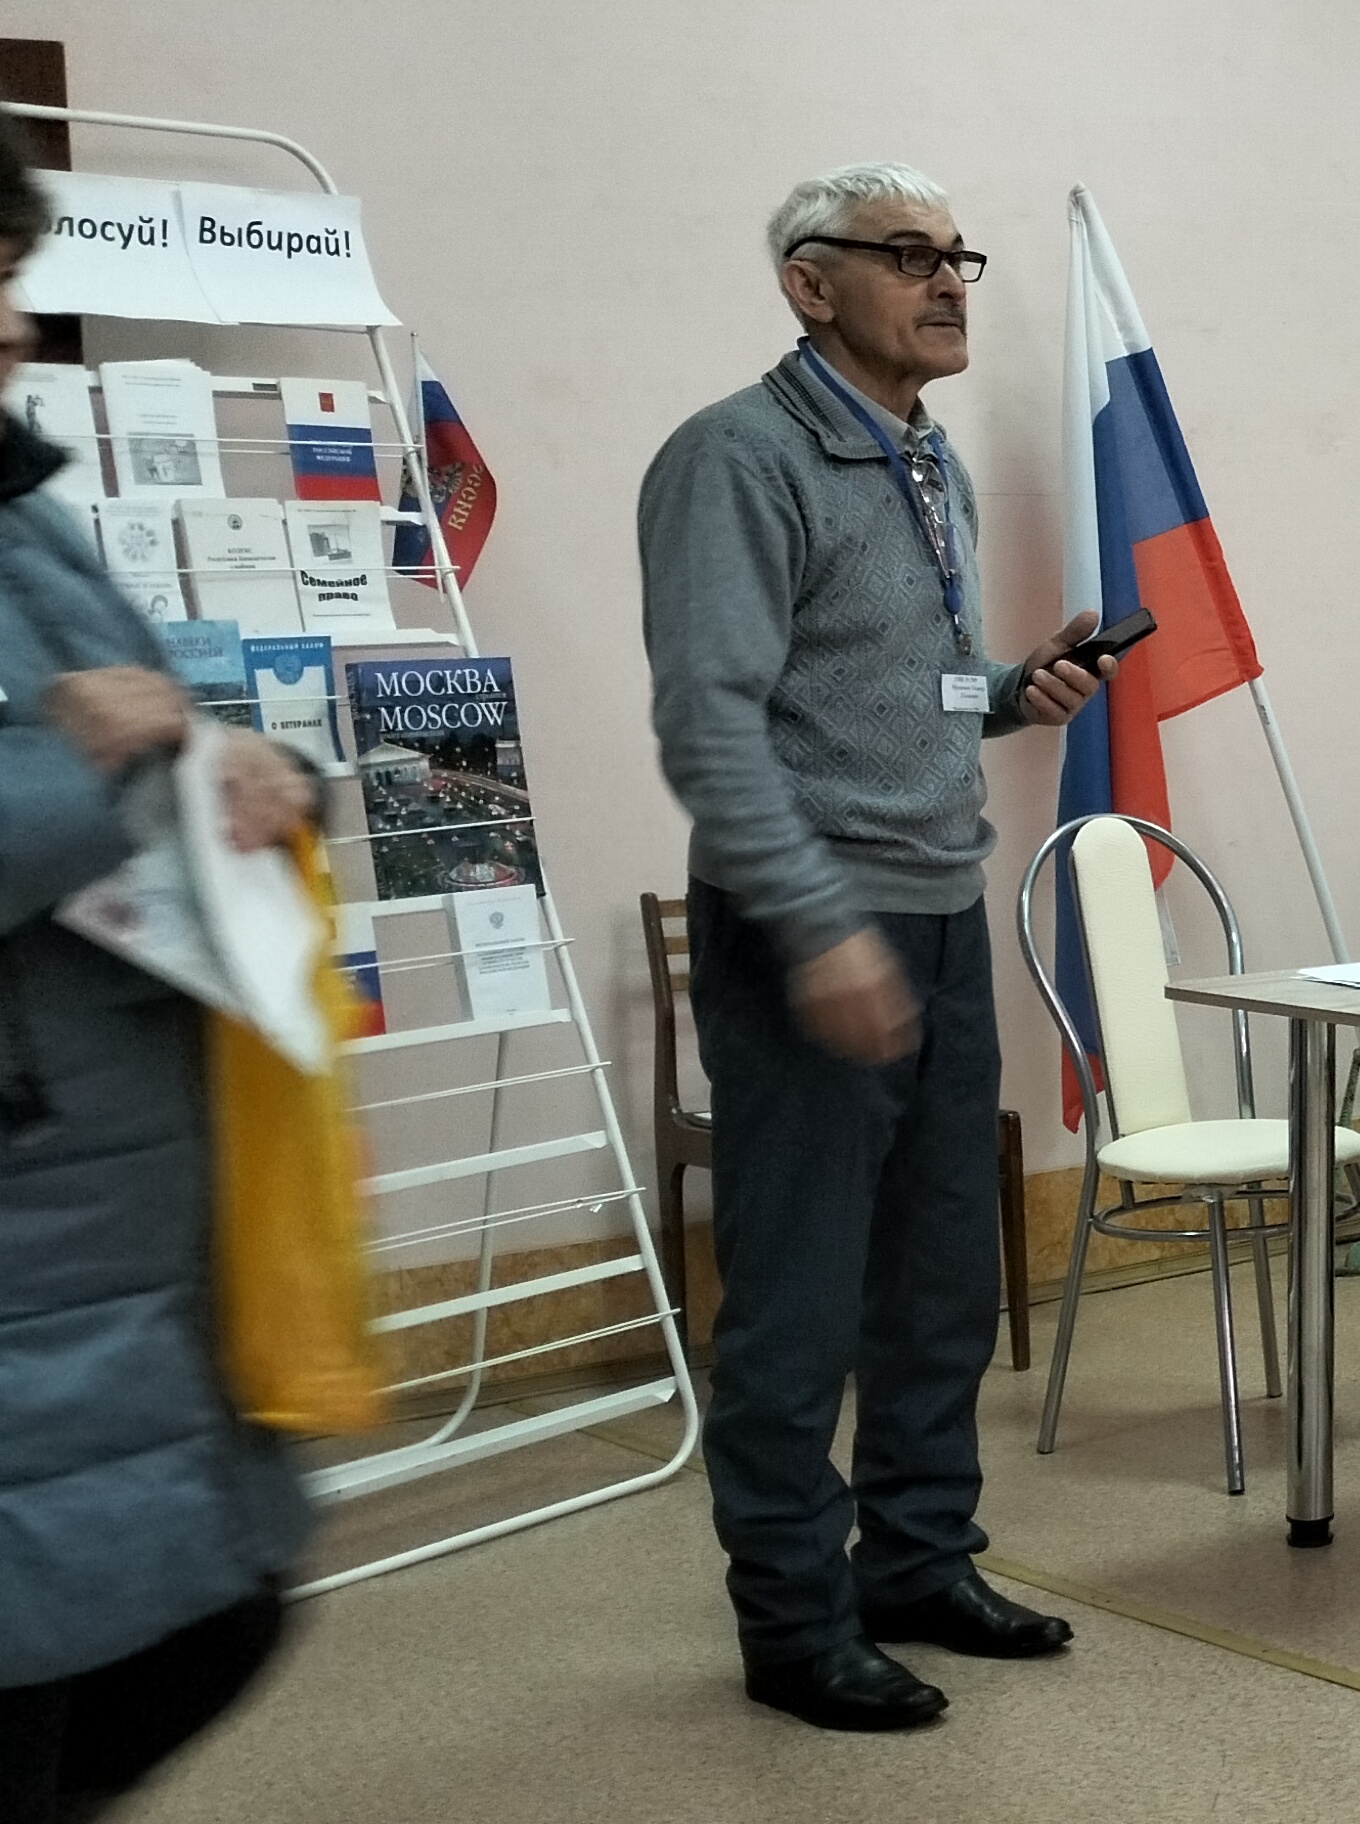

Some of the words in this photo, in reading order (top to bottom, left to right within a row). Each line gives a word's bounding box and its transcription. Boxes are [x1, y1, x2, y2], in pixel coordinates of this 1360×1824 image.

[53, 215, 169, 250] лосуй!
[198, 215, 352, 259] Выбирай!
[300, 570, 368, 588] Семейное
[318, 592, 359, 602] право
[374, 668, 501, 698] МОСКВА
[377, 701, 509, 732] MOSCOW
